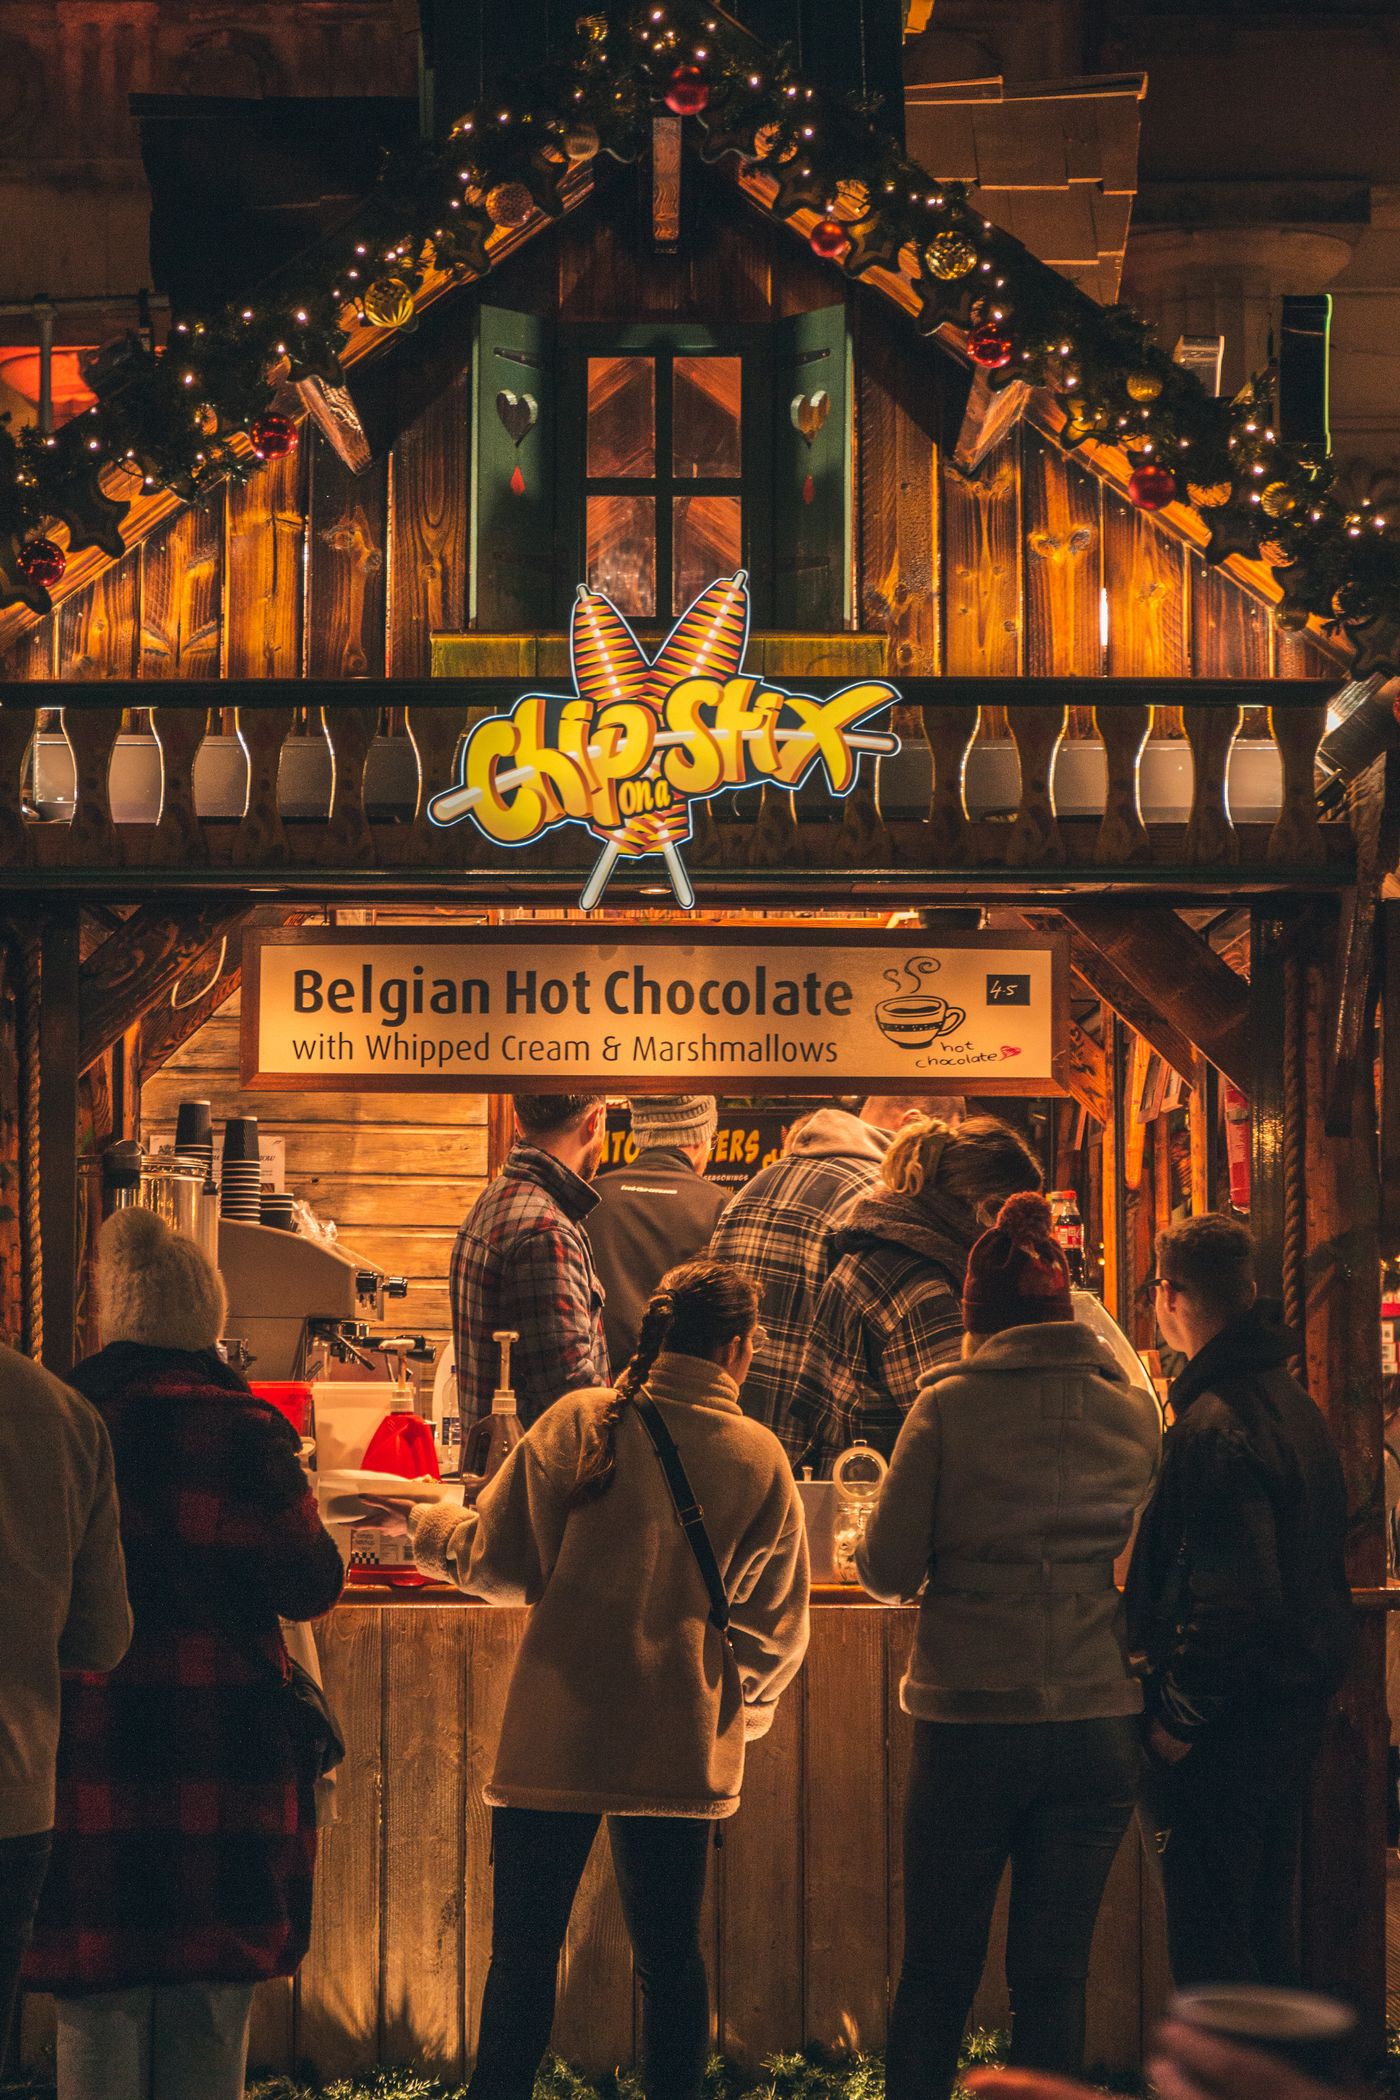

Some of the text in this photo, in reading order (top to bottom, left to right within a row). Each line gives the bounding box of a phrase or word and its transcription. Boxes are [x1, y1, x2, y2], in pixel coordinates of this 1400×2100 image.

[619, 778, 671, 815] on a
[294, 964, 853, 1028] Belgian Hot Chocolate
[292, 1032, 838, 1068] with Whipped Cream & Marshmallows
[915, 1052, 998, 1068] chocolate
[940, 1041, 975, 1053] hot
